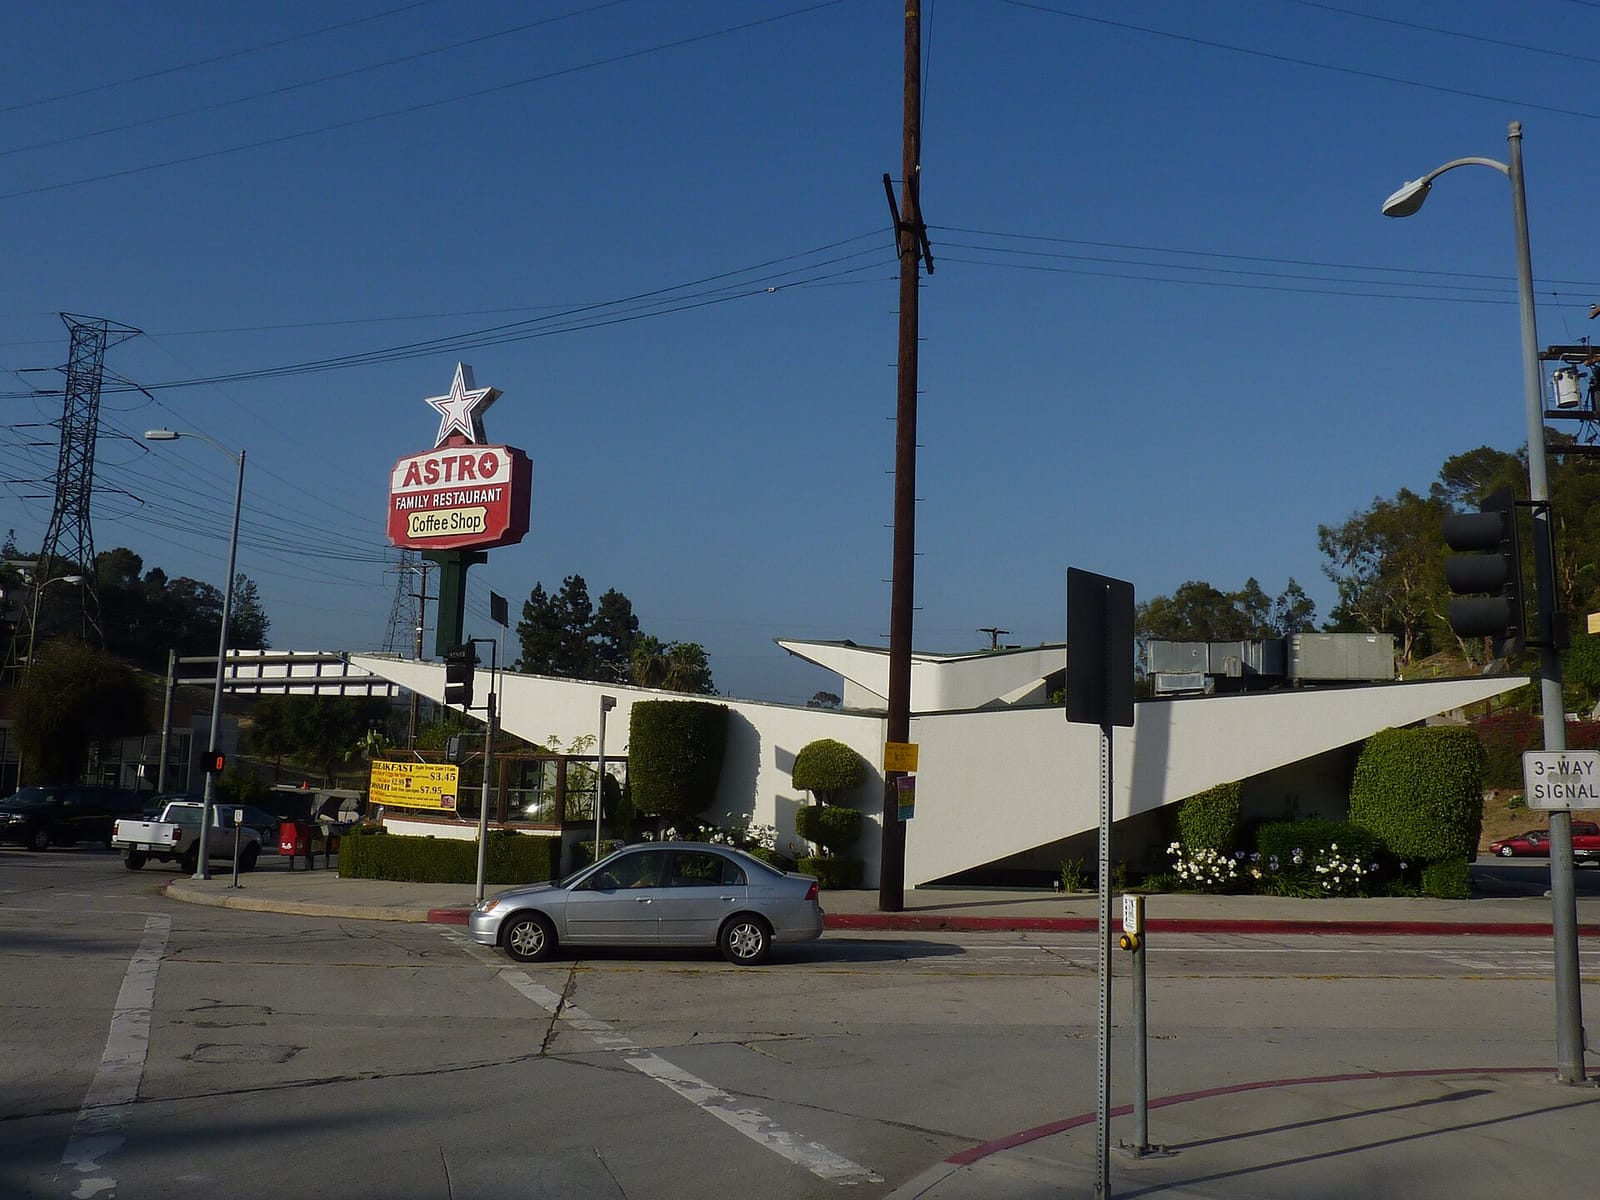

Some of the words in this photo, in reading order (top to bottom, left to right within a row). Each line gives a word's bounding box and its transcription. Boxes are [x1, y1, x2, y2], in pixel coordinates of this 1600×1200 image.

[402, 452, 499, 487] ASTRO
[396, 494, 429, 510] FAMILY
[432, 488, 502, 507] RESTAURANT
[412, 514, 448, 533] Coffee
[450, 512, 481, 532] Shop
[373, 762, 413, 772] BREAKFAST
[1534, 760, 1594, 776] 3-WAY
[430, 772, 456, 781] $3.45
[420, 786, 442, 795] $7.95
[1534, 784, 1599, 799] SIGNAL
